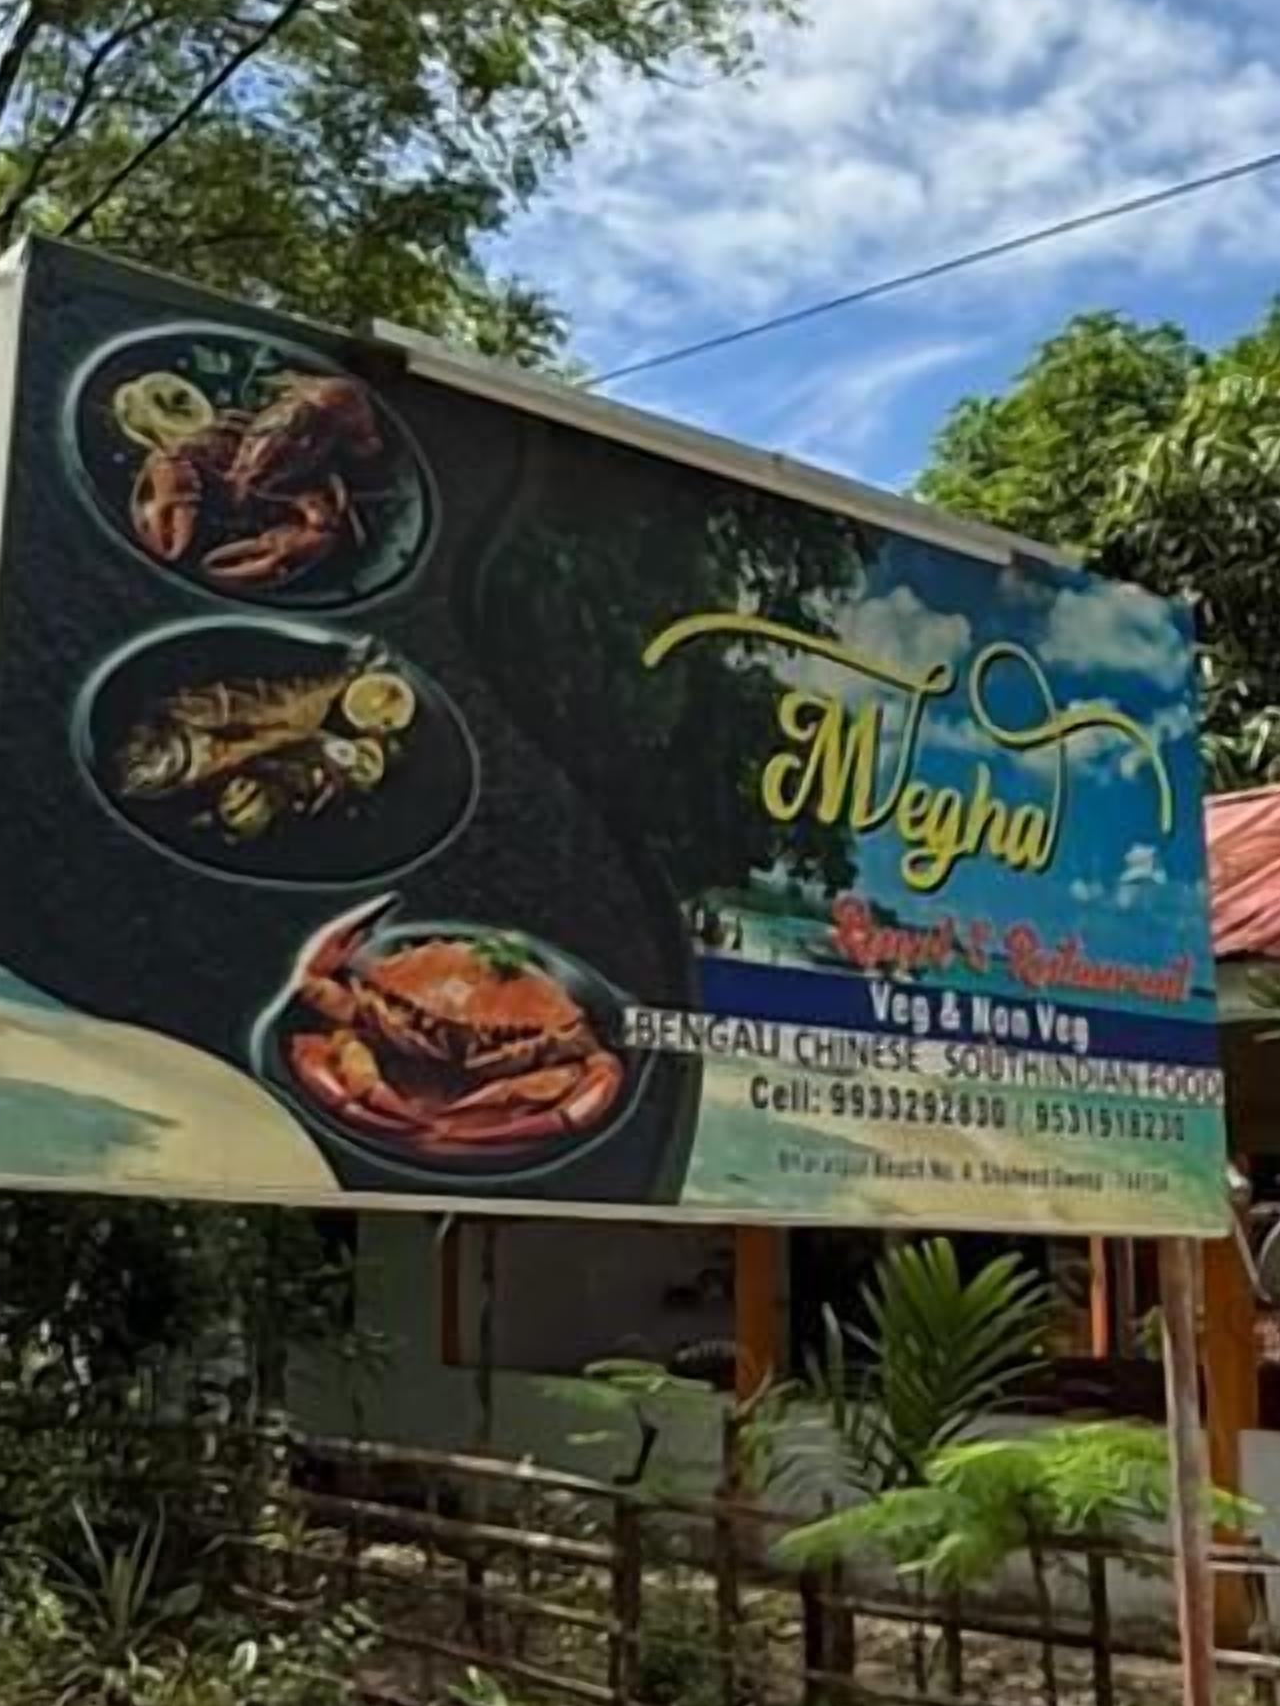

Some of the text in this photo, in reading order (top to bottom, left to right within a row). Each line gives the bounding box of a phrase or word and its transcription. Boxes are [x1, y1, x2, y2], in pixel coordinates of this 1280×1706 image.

[869, 981, 1089, 1053] Veg & Non Veg
[793, 1031, 920, 1073] CHINESE
[750, 1074, 821, 1114] Cell:
